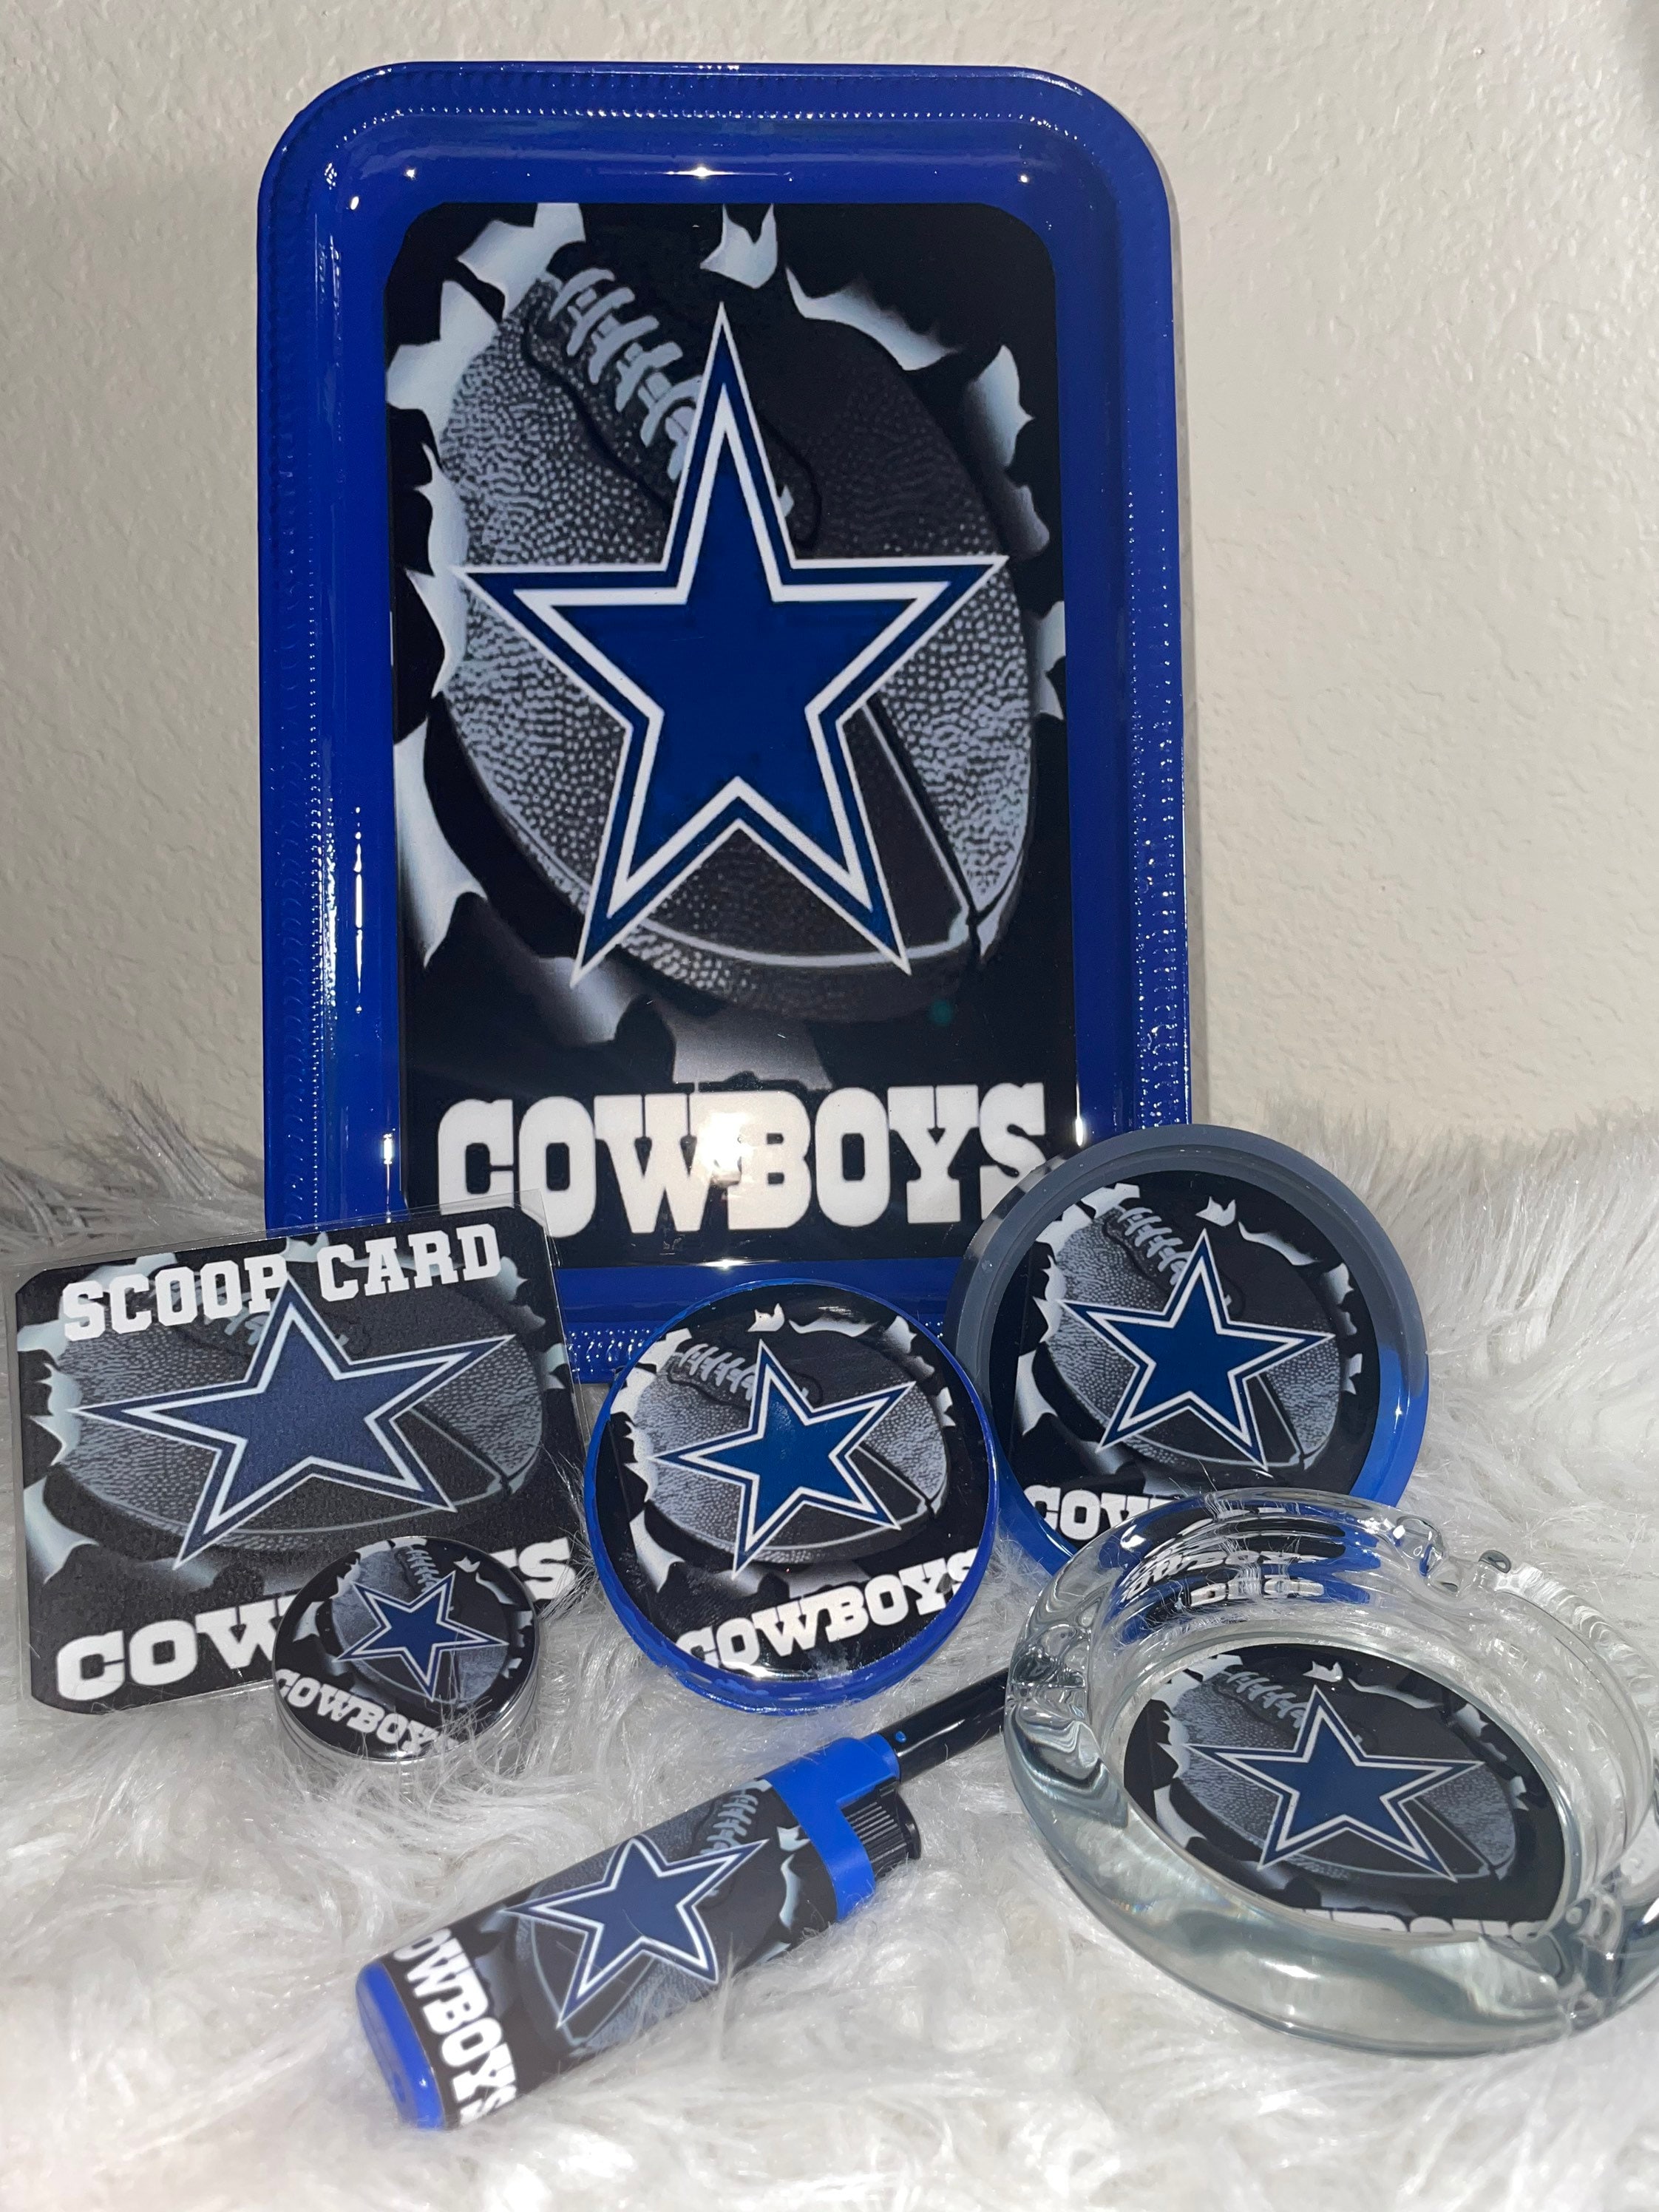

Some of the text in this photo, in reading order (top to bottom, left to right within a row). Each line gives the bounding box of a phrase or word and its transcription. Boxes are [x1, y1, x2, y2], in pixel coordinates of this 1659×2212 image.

[438, 1082, 1047, 1238] COWBOYS
[62, 1224, 501, 1342] SCOOP CARD
[56, 1536, 577, 1700] COWS
[275, 1669, 460, 1755] COWBOY
[393, 1928, 517, 2126] OWBOYS
